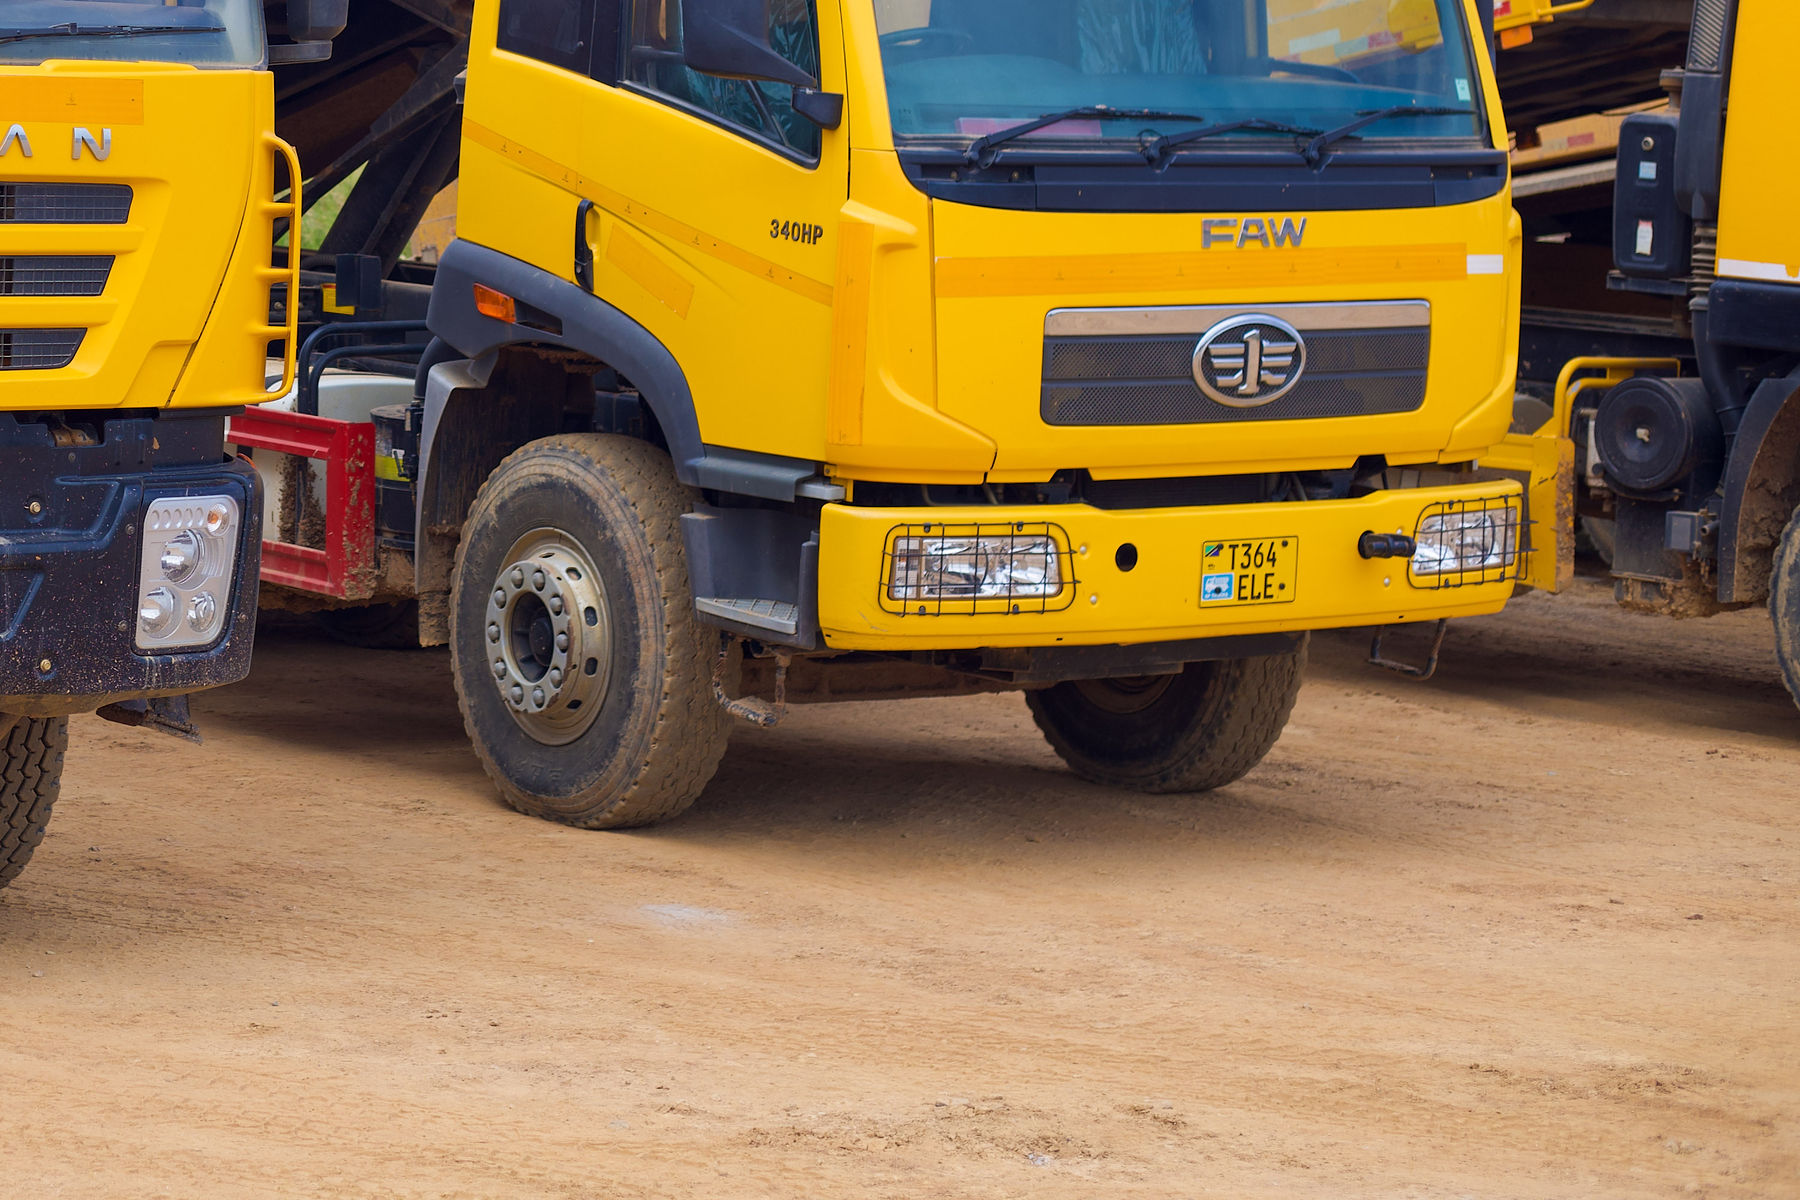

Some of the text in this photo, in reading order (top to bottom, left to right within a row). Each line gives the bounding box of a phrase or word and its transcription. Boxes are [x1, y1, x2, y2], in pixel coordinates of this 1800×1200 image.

[770, 218, 824, 245] 340HP
[1201, 216, 1307, 249] FAW
[1228, 541, 1277, 570] T364
[1238, 573, 1275, 601] ELE
